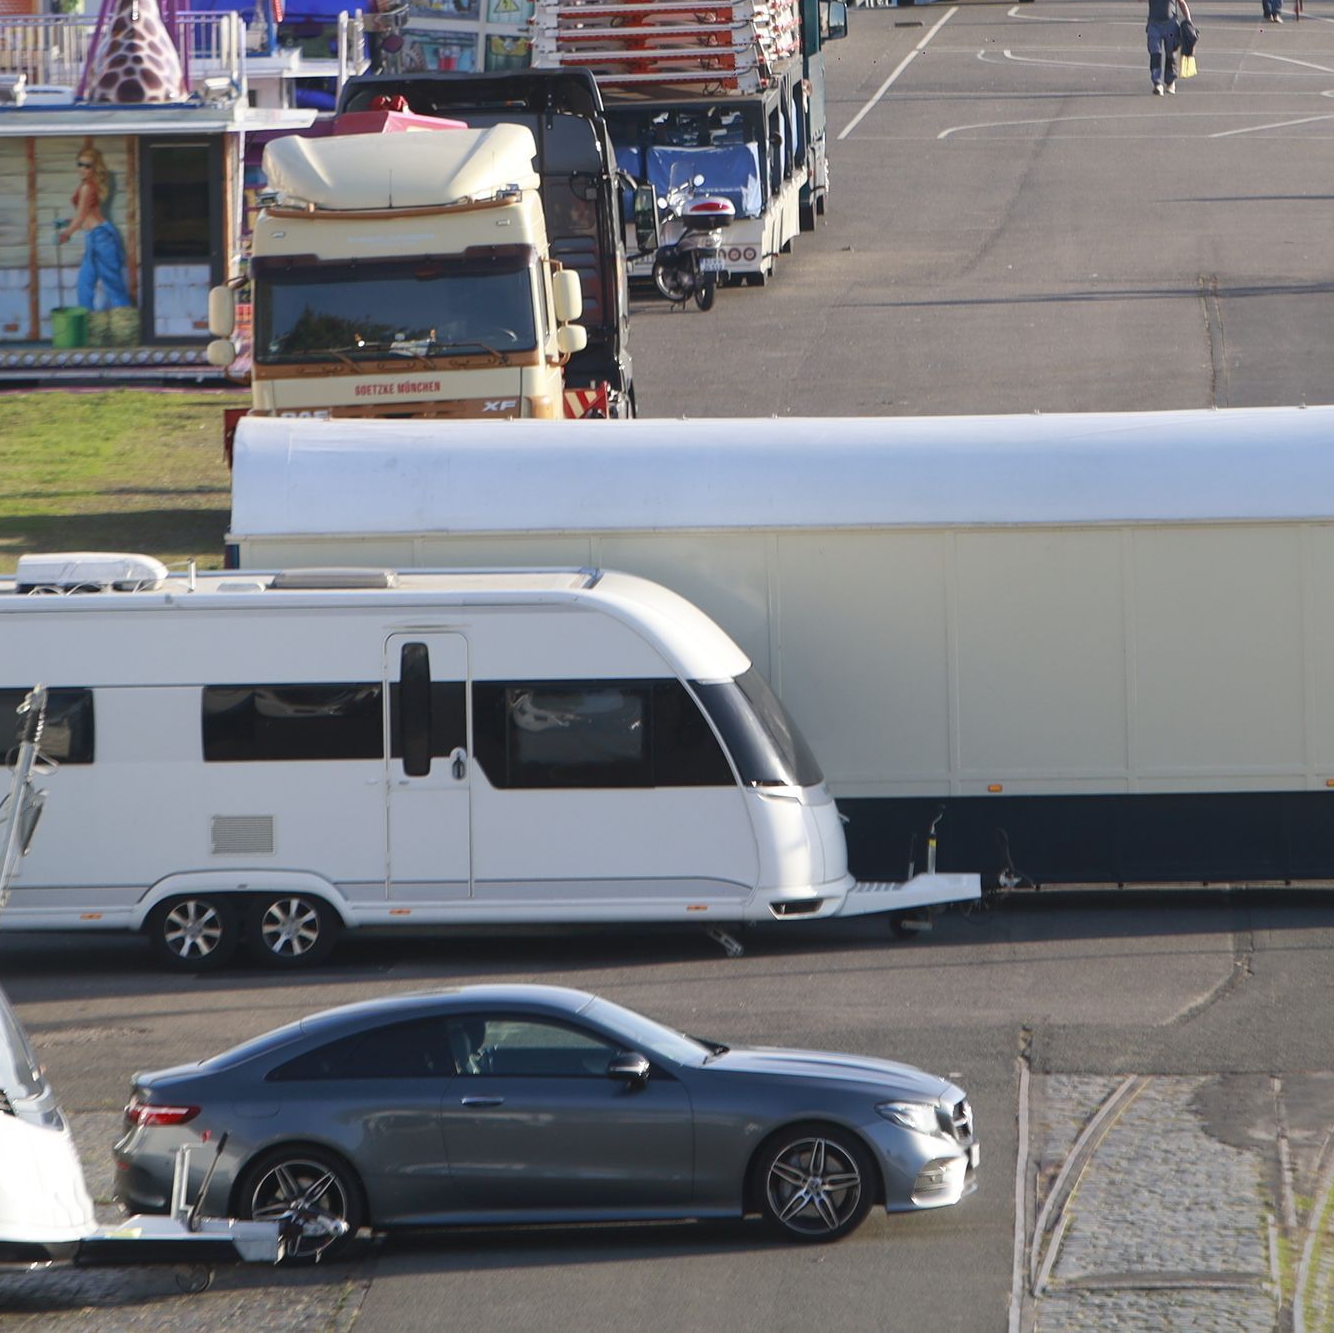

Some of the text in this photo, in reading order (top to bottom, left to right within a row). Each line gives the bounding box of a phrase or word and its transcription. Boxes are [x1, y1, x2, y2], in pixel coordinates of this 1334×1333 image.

[355, 380, 441, 396] GOETZKE MÜNCHEN
[482, 400, 519, 412] XF
